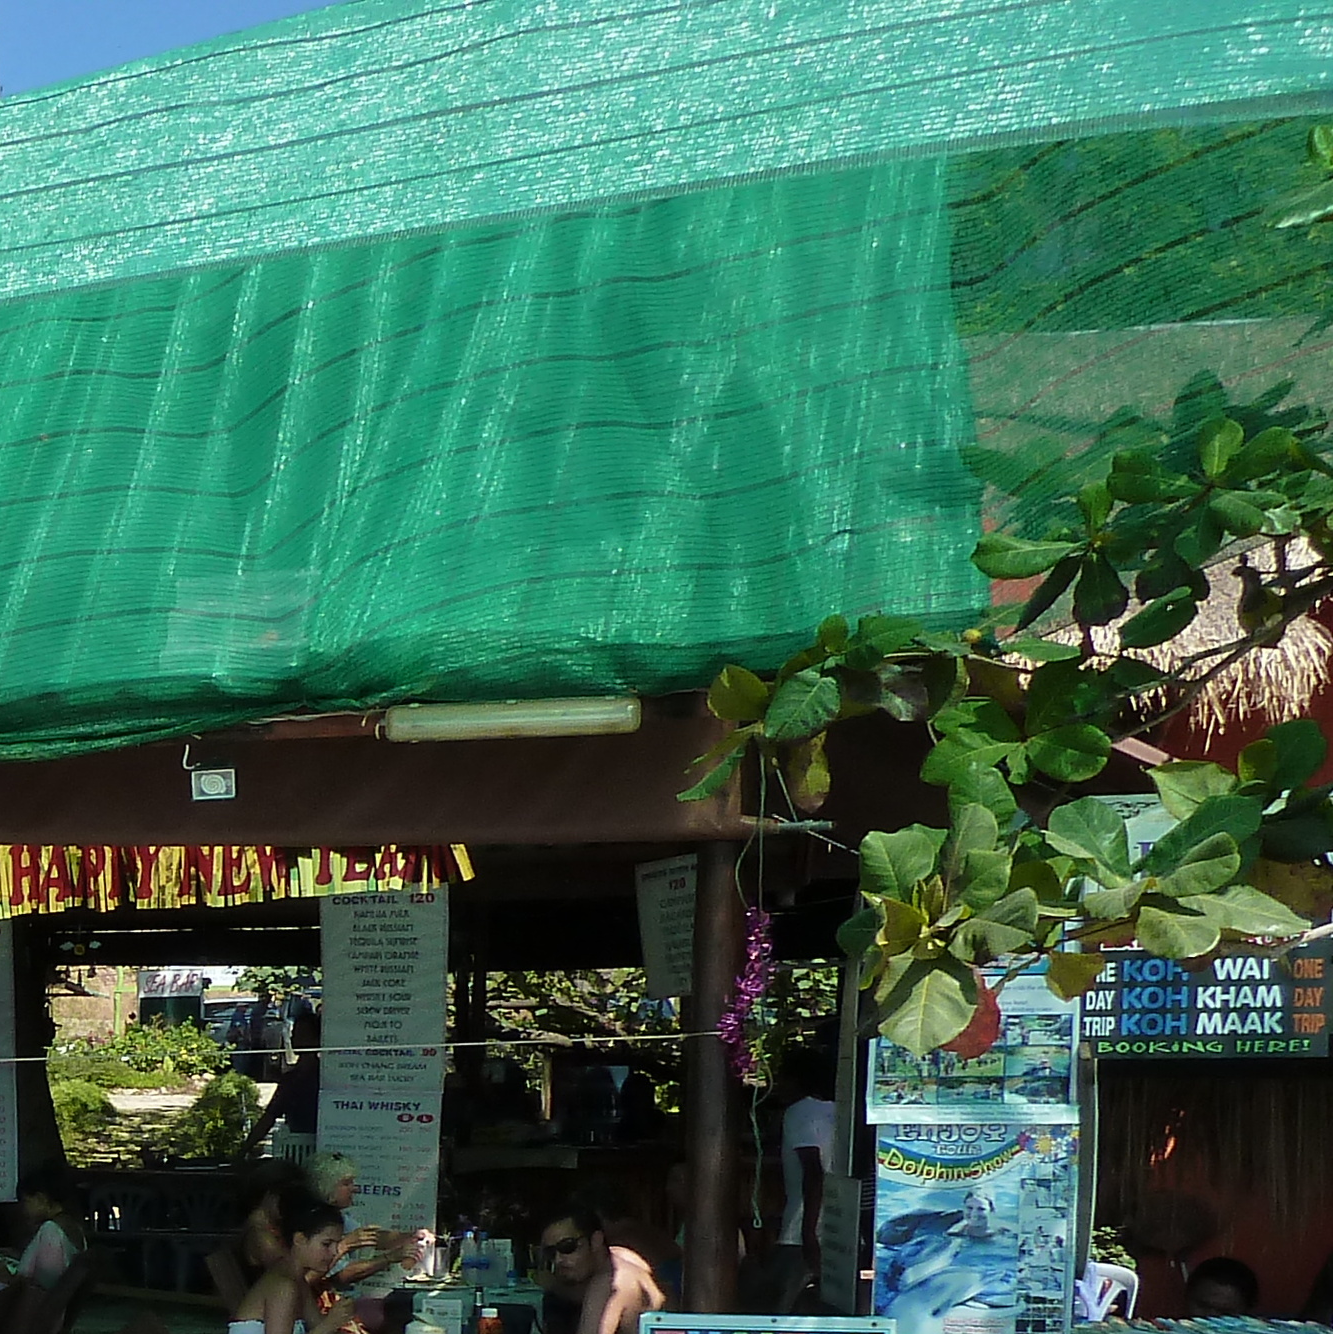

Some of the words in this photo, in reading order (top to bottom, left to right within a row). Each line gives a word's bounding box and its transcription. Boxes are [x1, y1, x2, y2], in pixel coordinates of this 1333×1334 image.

[332, 894, 398, 905] COCKTAIL
[409, 892, 435, 904] 120
[143, 973, 167, 994] SEA
[170, 970, 199, 993] BAR
[1122, 958, 1191, 983] KOH
[1213, 956, 1271, 981] WAI
[1293, 958, 1324, 979] ONE
[1085, 989, 1116, 1011] DAY
[1121, 985, 1190, 1009] KOH
[1196, 984, 1283, 1009] KHAM
[1292, 986, 1325, 1008] DAY
[1083, 1015, 1116, 1037] TRIP
[1120, 1012, 1188, 1037] KOH
[1195, 1011, 1284, 1036] MAAK
[1292, 1013, 1326, 1034] TRIP
[1235, 1039, 1311, 1054] HERE!
[332, 1100, 364, 1110] THAI
[368, 1100, 421, 1111] WHISKY
[883, 1147, 966, 1185] Dolphin
[969, 1149, 1014, 1180] Show
